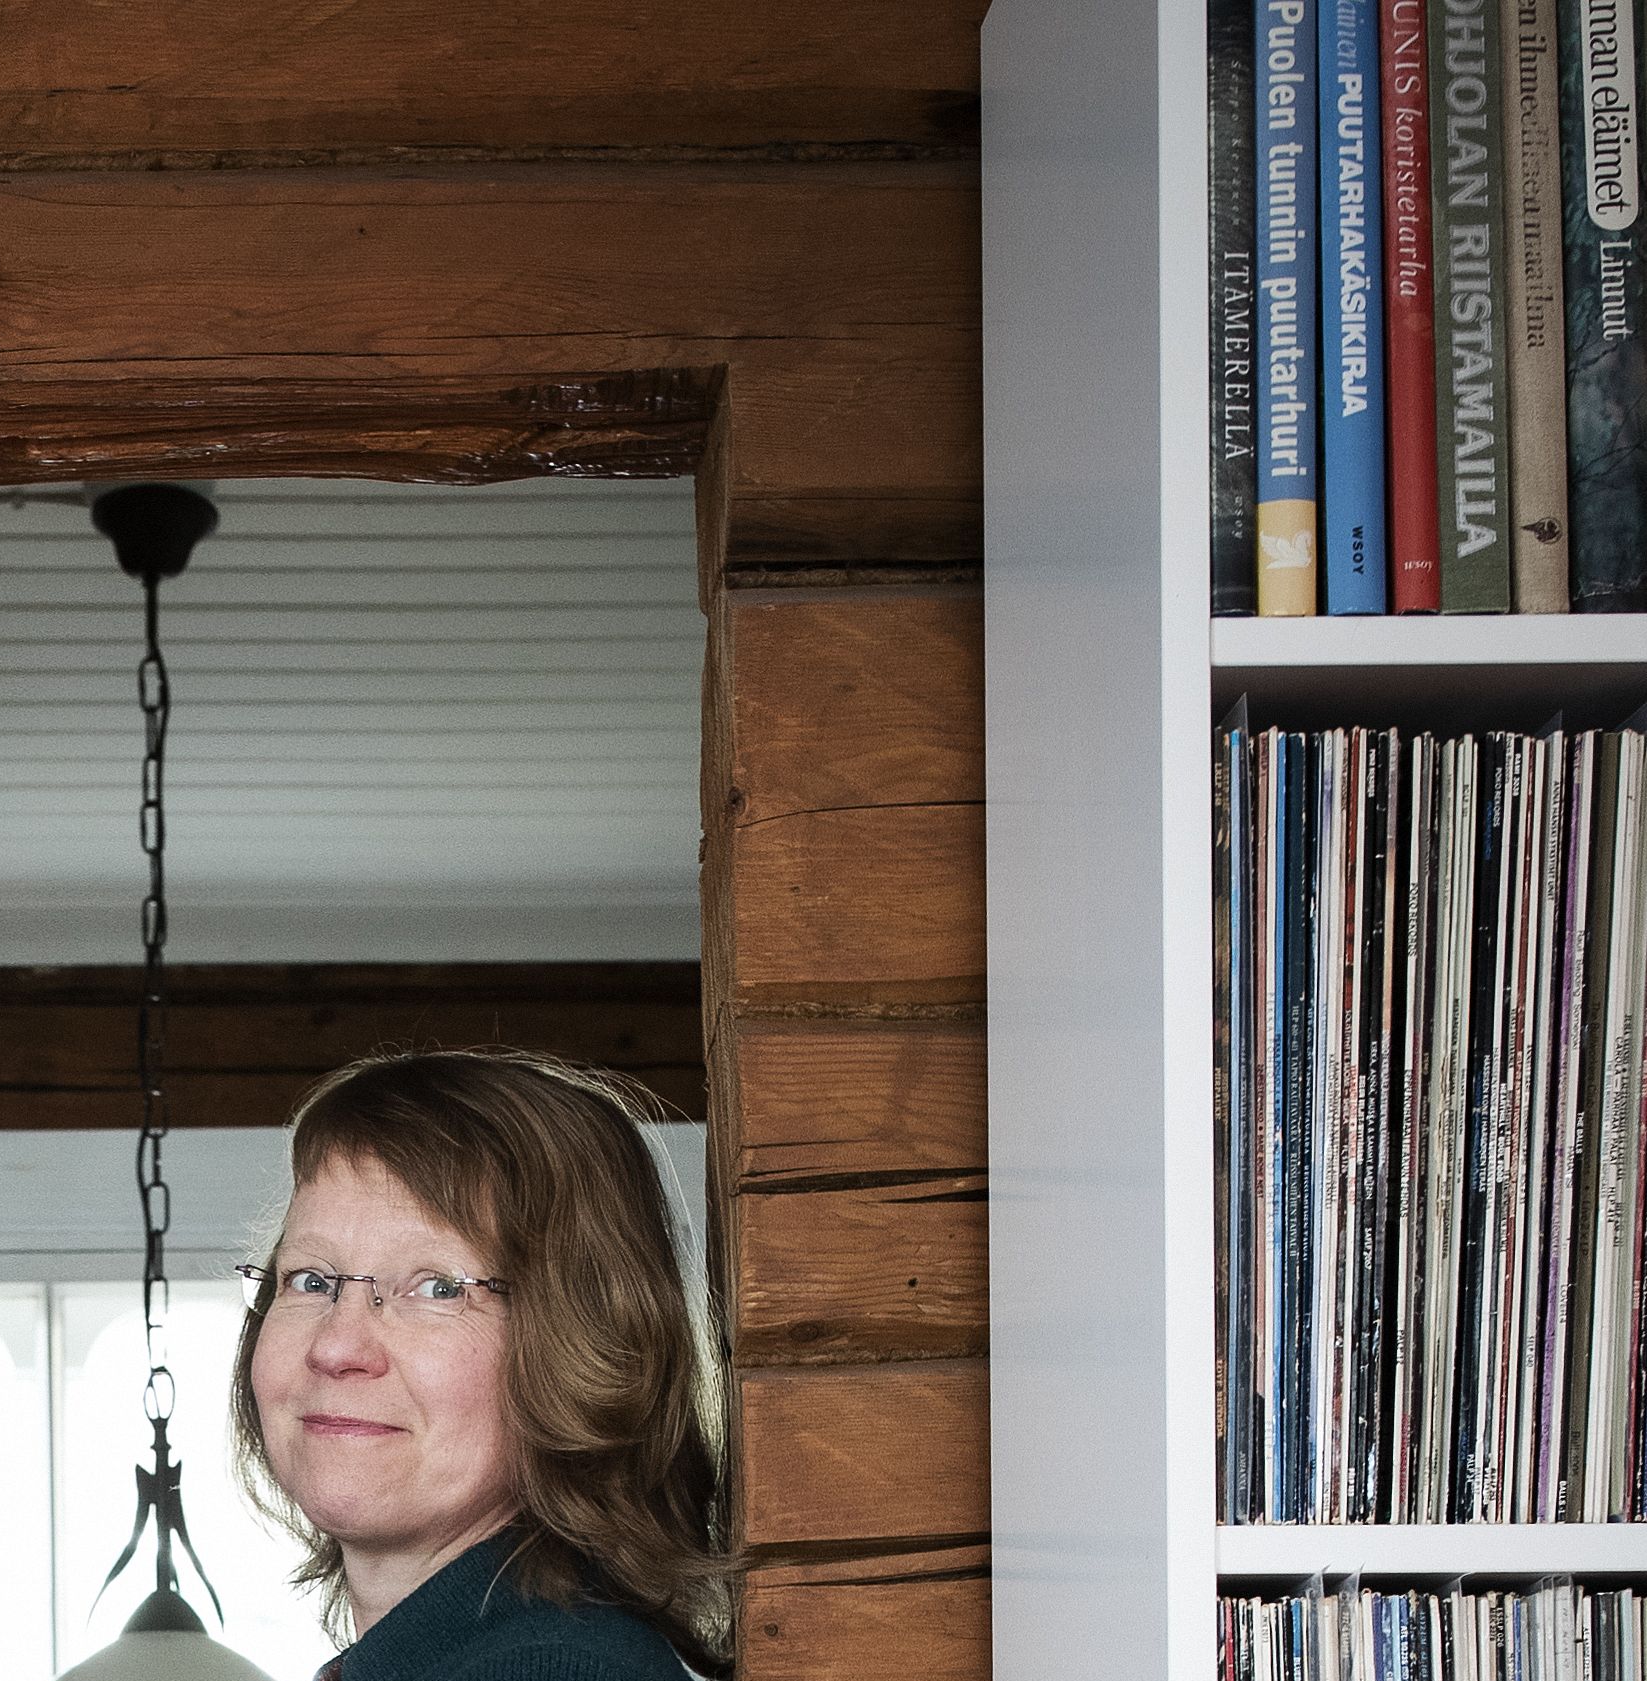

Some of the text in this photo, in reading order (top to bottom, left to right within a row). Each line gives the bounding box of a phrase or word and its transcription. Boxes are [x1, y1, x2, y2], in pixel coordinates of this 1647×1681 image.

[1392, 1, 1426, 298] UNIS koristetarha
[1590, 87, 1632, 216] eläimet
[1260, 1, 1308, 477] Puolen tunnin puutarhuri
[1337, 73, 1372, 418] PUUTARHAKÄSIKIRJA
[1599, 237, 1634, 342] Linnut
[1224, 250, 1254, 461] ITÄMERELLÄ
[1449, 224, 1497, 559] RIISTAMAILLA
[1351, 525, 1365, 575] WSOY
[1291, 1056, 1299, 1082] TAPIO
[1482, 1055, 1491, 1092] HASSISEN
[1613, 1037, 1622, 1075] CAROLA
[1290, 1084, 1299, 1143] RAUTAVAARA
[1481, 1095, 1489, 1113] KONE
[1575, 1112, 1584, 1154] THE BALLS
[1289, 1218, 1298, 1247] TAIVAL
